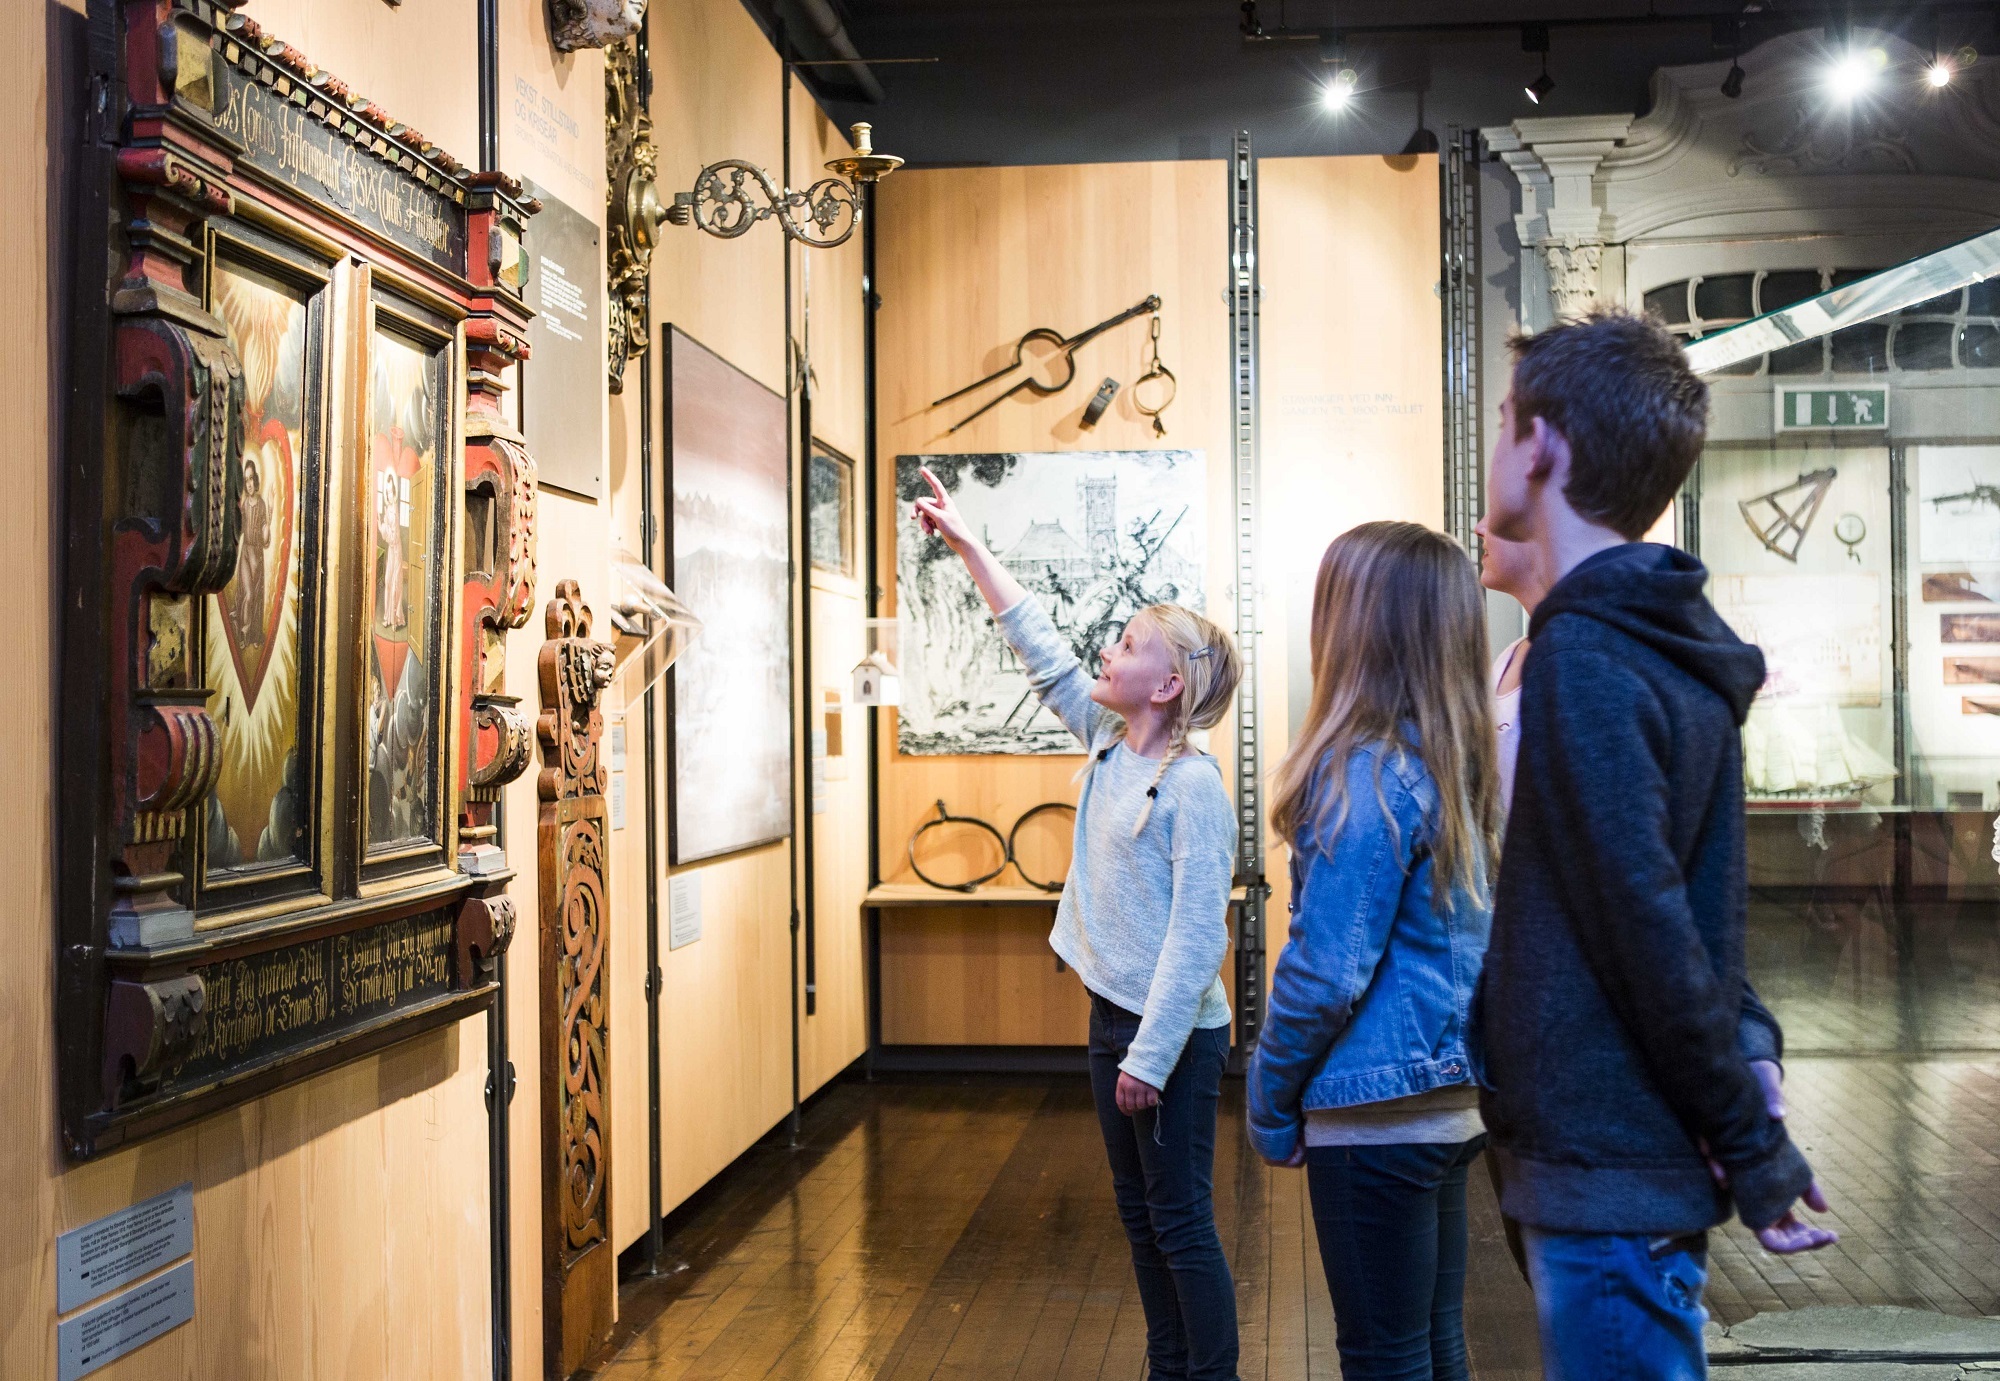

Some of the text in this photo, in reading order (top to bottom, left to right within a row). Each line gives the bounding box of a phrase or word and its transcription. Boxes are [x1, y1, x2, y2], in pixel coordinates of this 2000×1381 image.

[514, 97, 527, 122] OG
[541, 96, 580, 140] STILLSTAND
[1281, 393, 1345, 405] STAVANGER
[1348, 393, 1371, 404] VED
